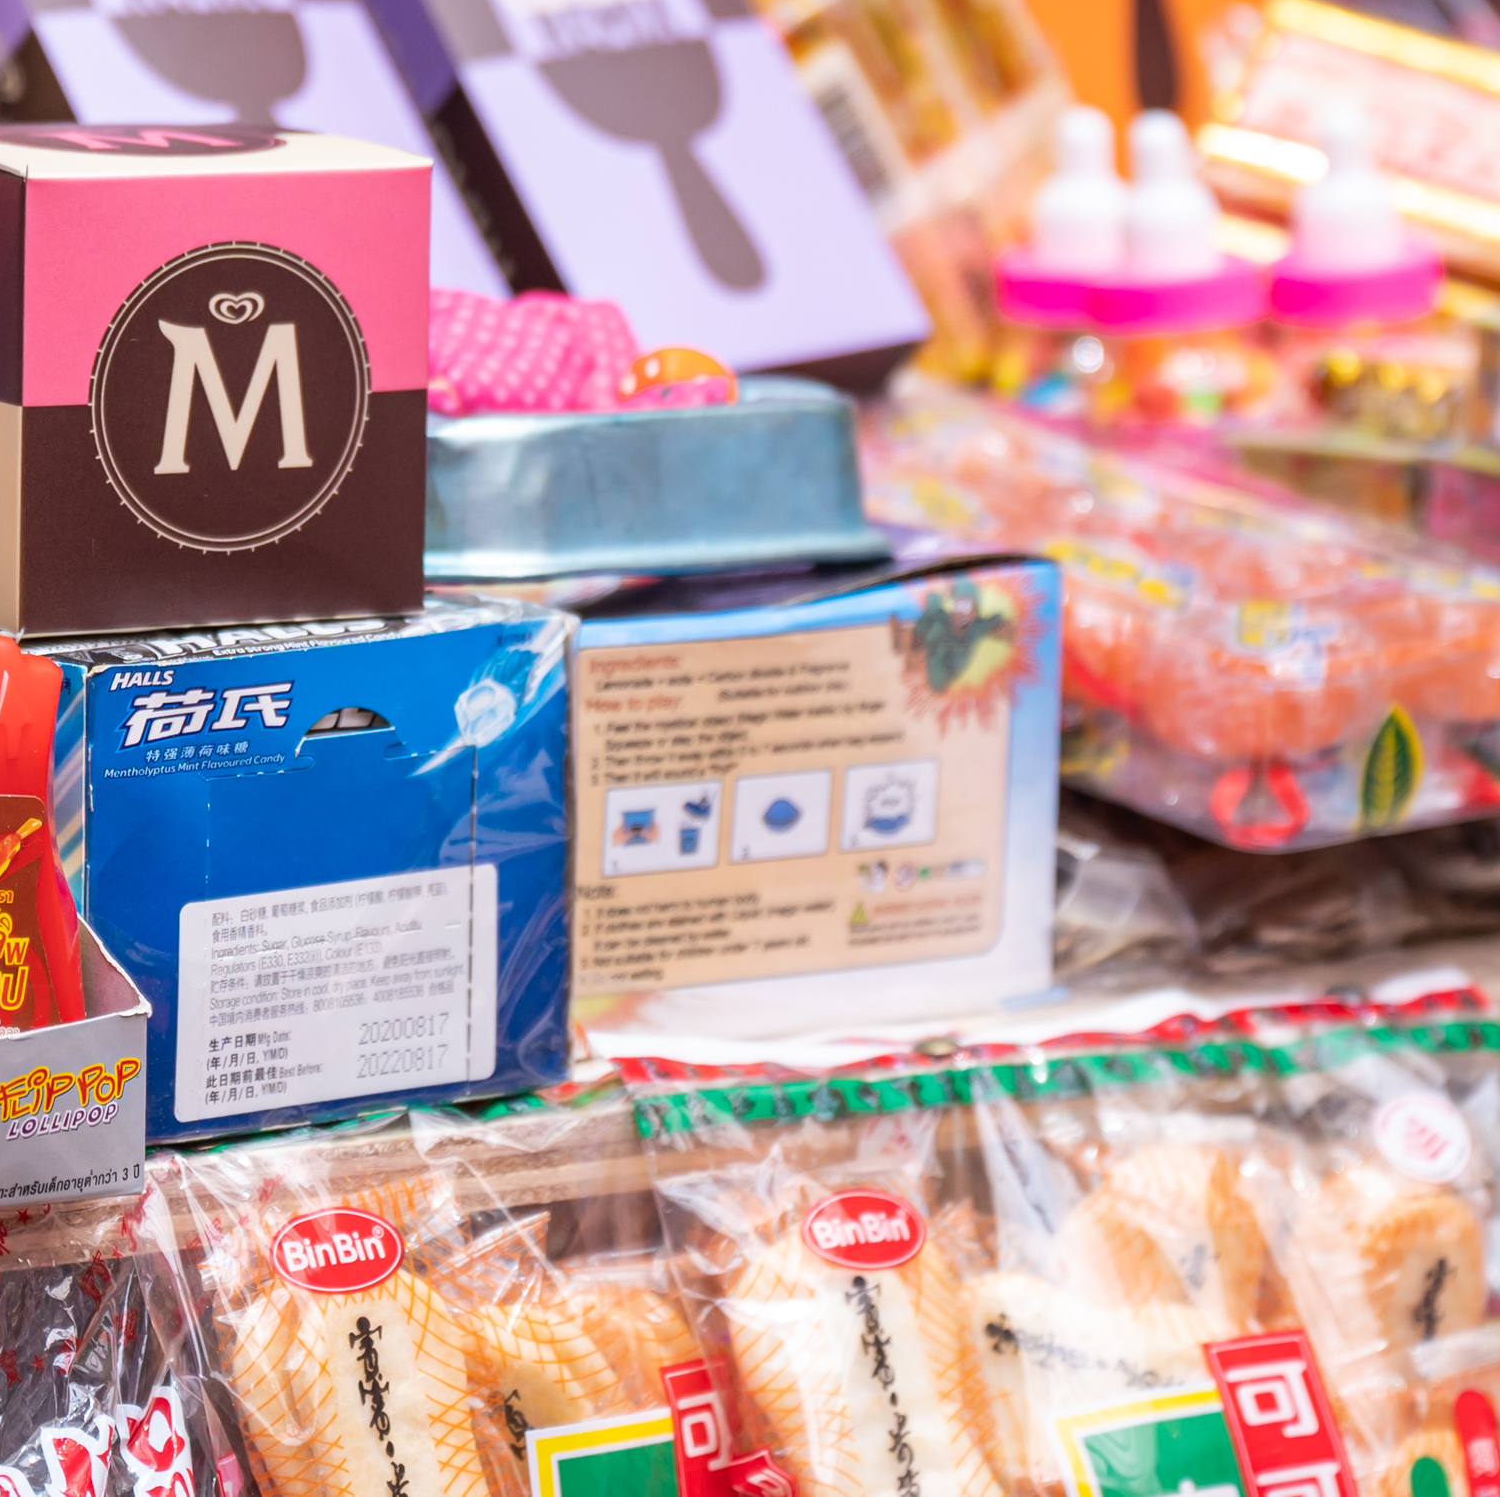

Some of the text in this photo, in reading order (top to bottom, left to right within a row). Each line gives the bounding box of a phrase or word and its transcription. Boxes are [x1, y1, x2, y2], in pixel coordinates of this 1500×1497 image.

[153, 319, 313, 475] M
[109, 670, 176, 691] HALLS
[124, 682, 293, 747] 荷氏
[103, 753, 286, 780] Mentholyptus Mint Flavoured Candy
[210, 959, 257, 977] Regulators
[208, 1033, 257, 1053] 生产日期
[358, 1012, 450, 1046] 20200817
[205, 1066, 278, 1089] 此日期前最佳
[356, 1044, 449, 1079] 20220817
[75, 1056, 142, 1107] POP
[6, 1102, 119, 1141] LOLLIPOP
[811, 1211, 911, 1251] BinBin
[282, 1230, 386, 1273] BinBin
